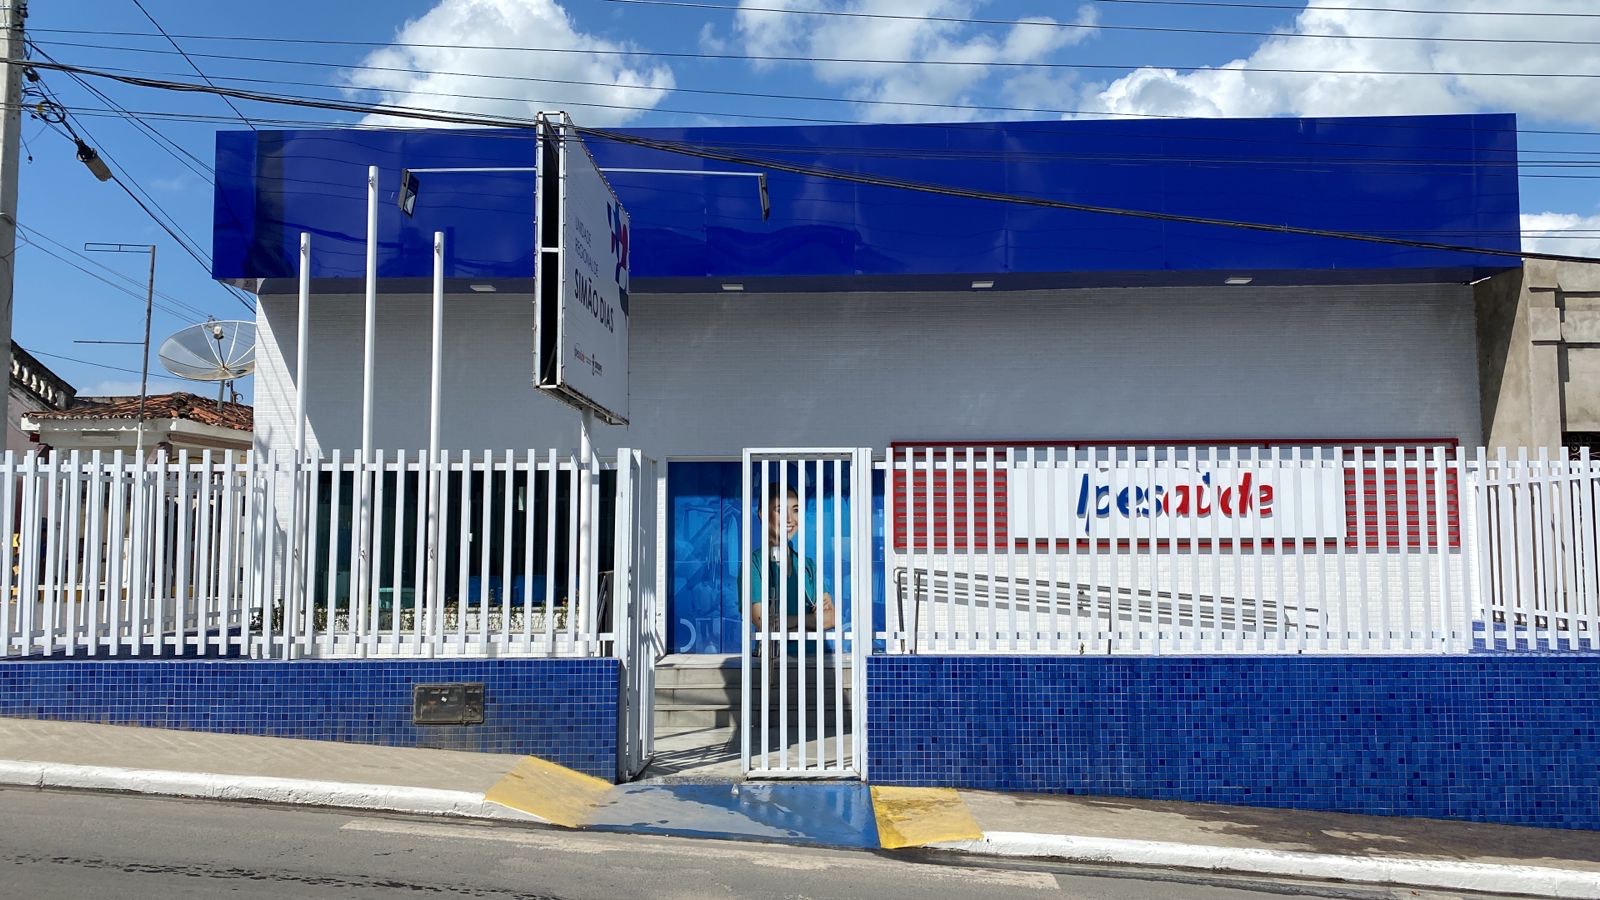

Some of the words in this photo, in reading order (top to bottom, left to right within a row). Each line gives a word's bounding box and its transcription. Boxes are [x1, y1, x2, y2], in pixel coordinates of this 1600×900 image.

[575, 216, 591, 248] UNIDADE
[575, 268, 598, 318] SIMÃO
[600, 296, 614, 333] DIAS
